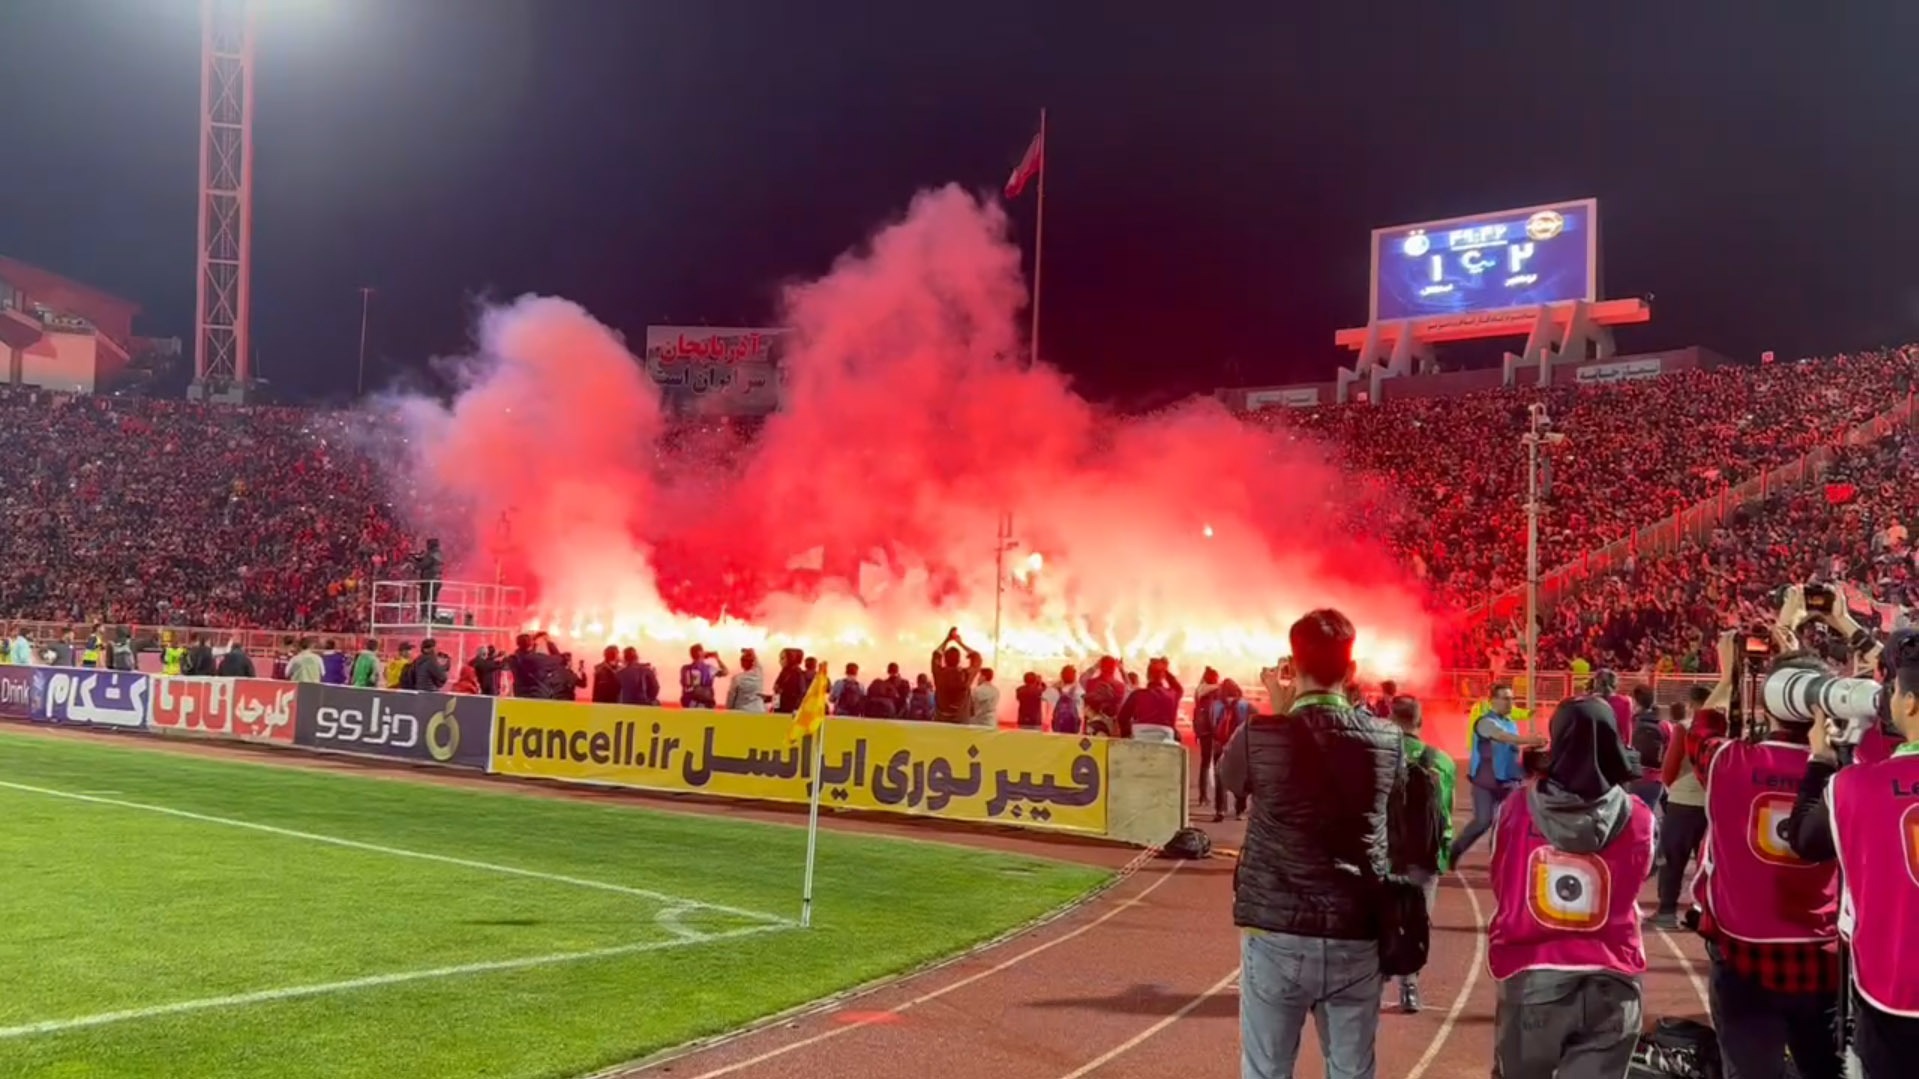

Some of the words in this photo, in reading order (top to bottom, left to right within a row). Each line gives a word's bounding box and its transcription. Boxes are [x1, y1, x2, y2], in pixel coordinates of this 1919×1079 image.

[660, 332, 761, 363] آذربایجان
[653, 367, 690, 385] است
[1, 678, 30, 705] Drink
[496, 716, 680, 770] Irancell.ir
[682, 726, 867, 802] ایرانسل
[871, 744, 982, 811] نوری
[985, 737, 1101, 821] فیبر
